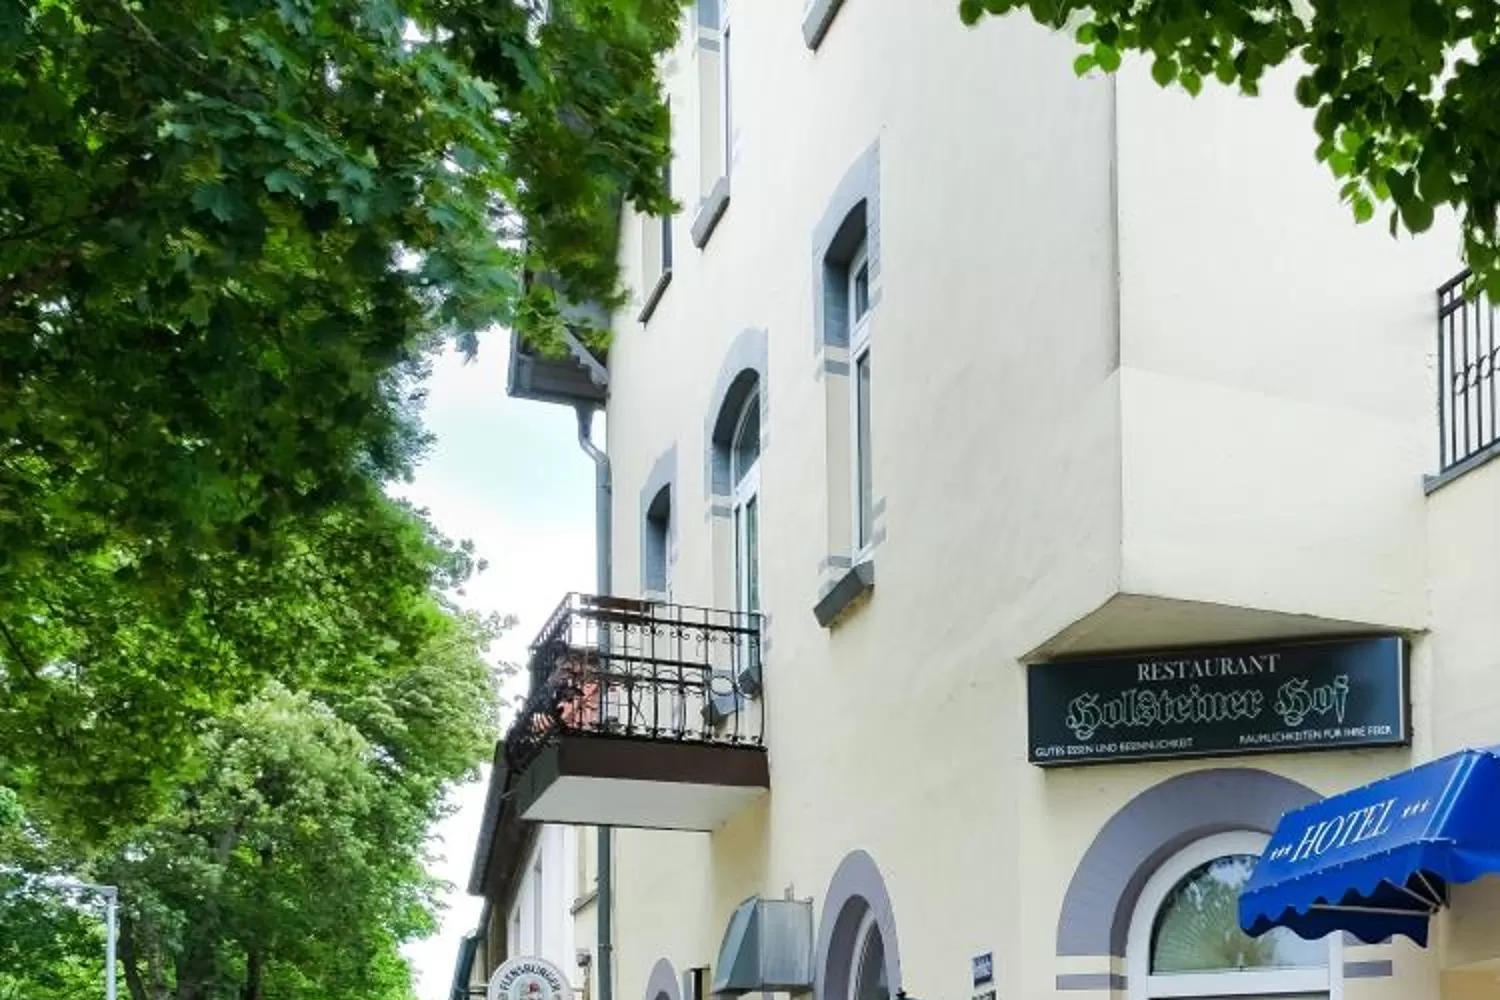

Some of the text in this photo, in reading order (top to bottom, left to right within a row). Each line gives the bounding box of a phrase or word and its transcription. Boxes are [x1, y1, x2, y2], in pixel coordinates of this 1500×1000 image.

[1137, 653, 1281, 682] RESTAURANT
[1065, 674, 1351, 741] Holsteiner Hof
[1095, 741, 1117, 754] UND
[1291, 799, 1396, 864] HOTEL
[500, 964, 561, 992] FLENSBURGER
